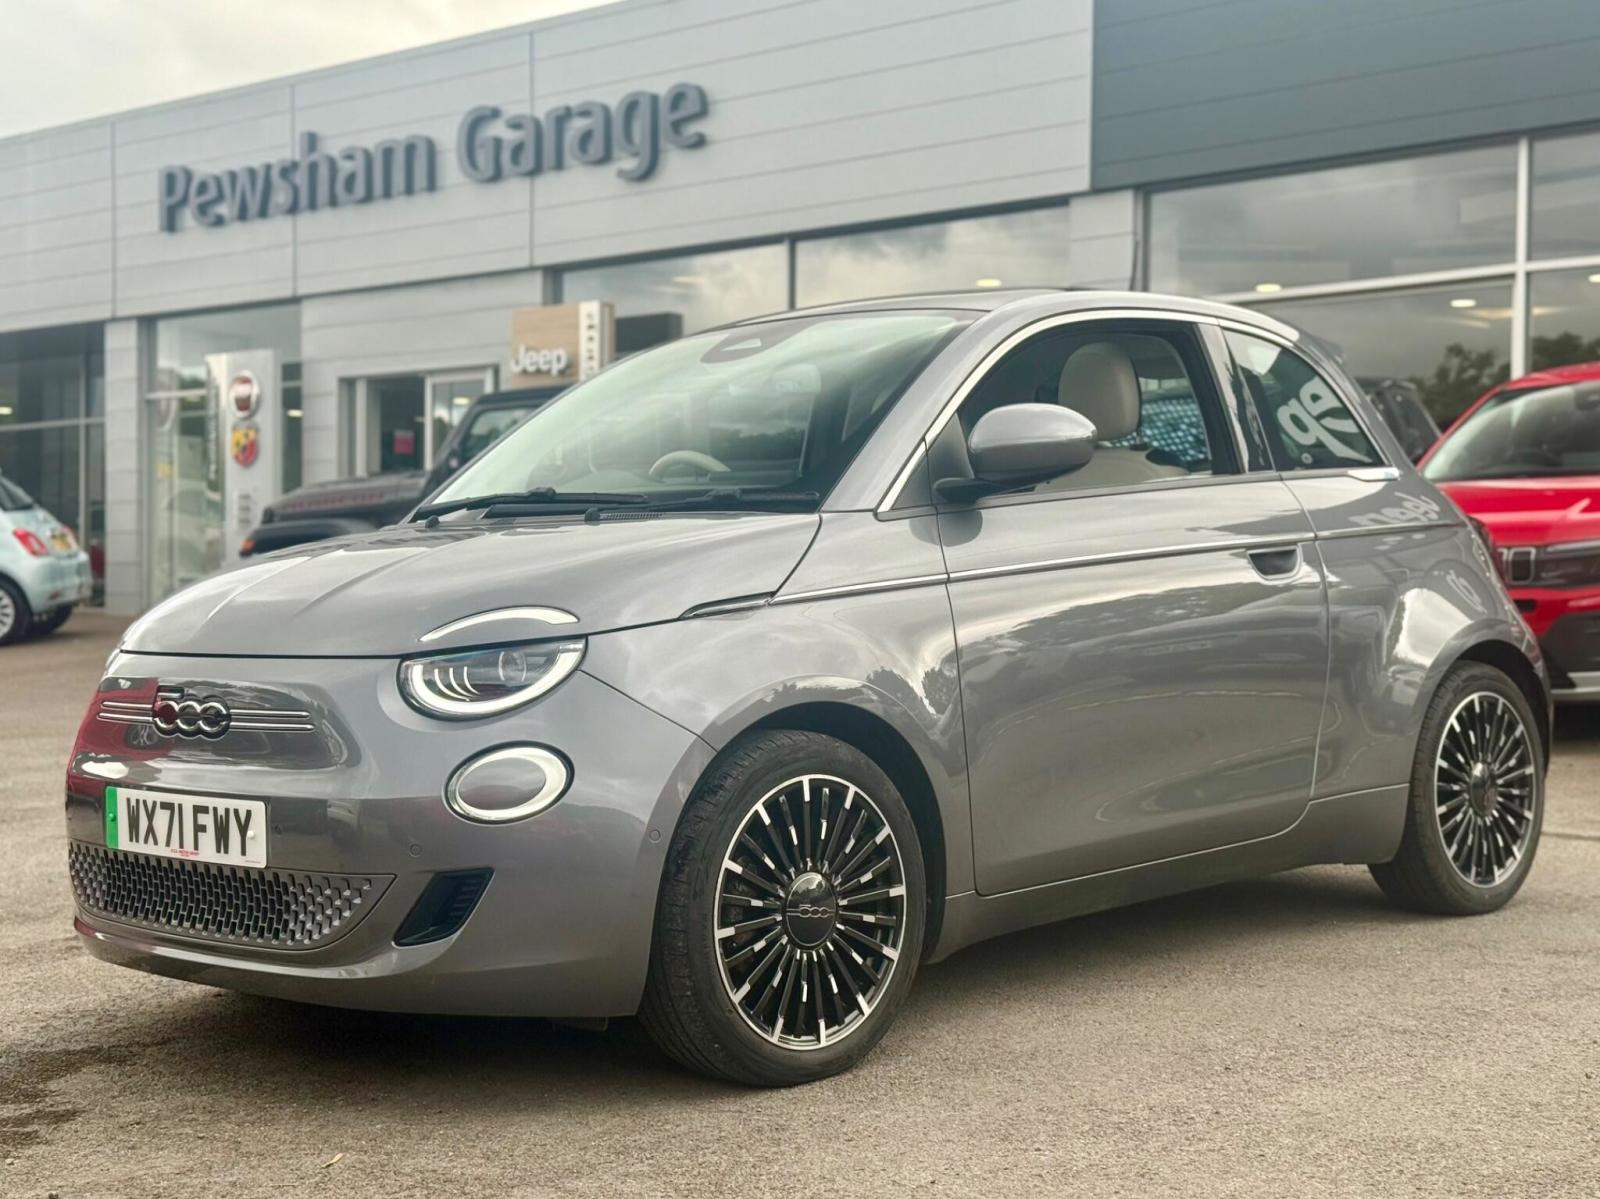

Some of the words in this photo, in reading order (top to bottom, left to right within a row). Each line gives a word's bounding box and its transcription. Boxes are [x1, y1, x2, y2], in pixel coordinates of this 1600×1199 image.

[158, 131, 437, 232] Pewsham
[457, 82, 709, 183] Garage
[510, 344, 567, 377] Jeep
[192, 804, 252, 857] FWY
